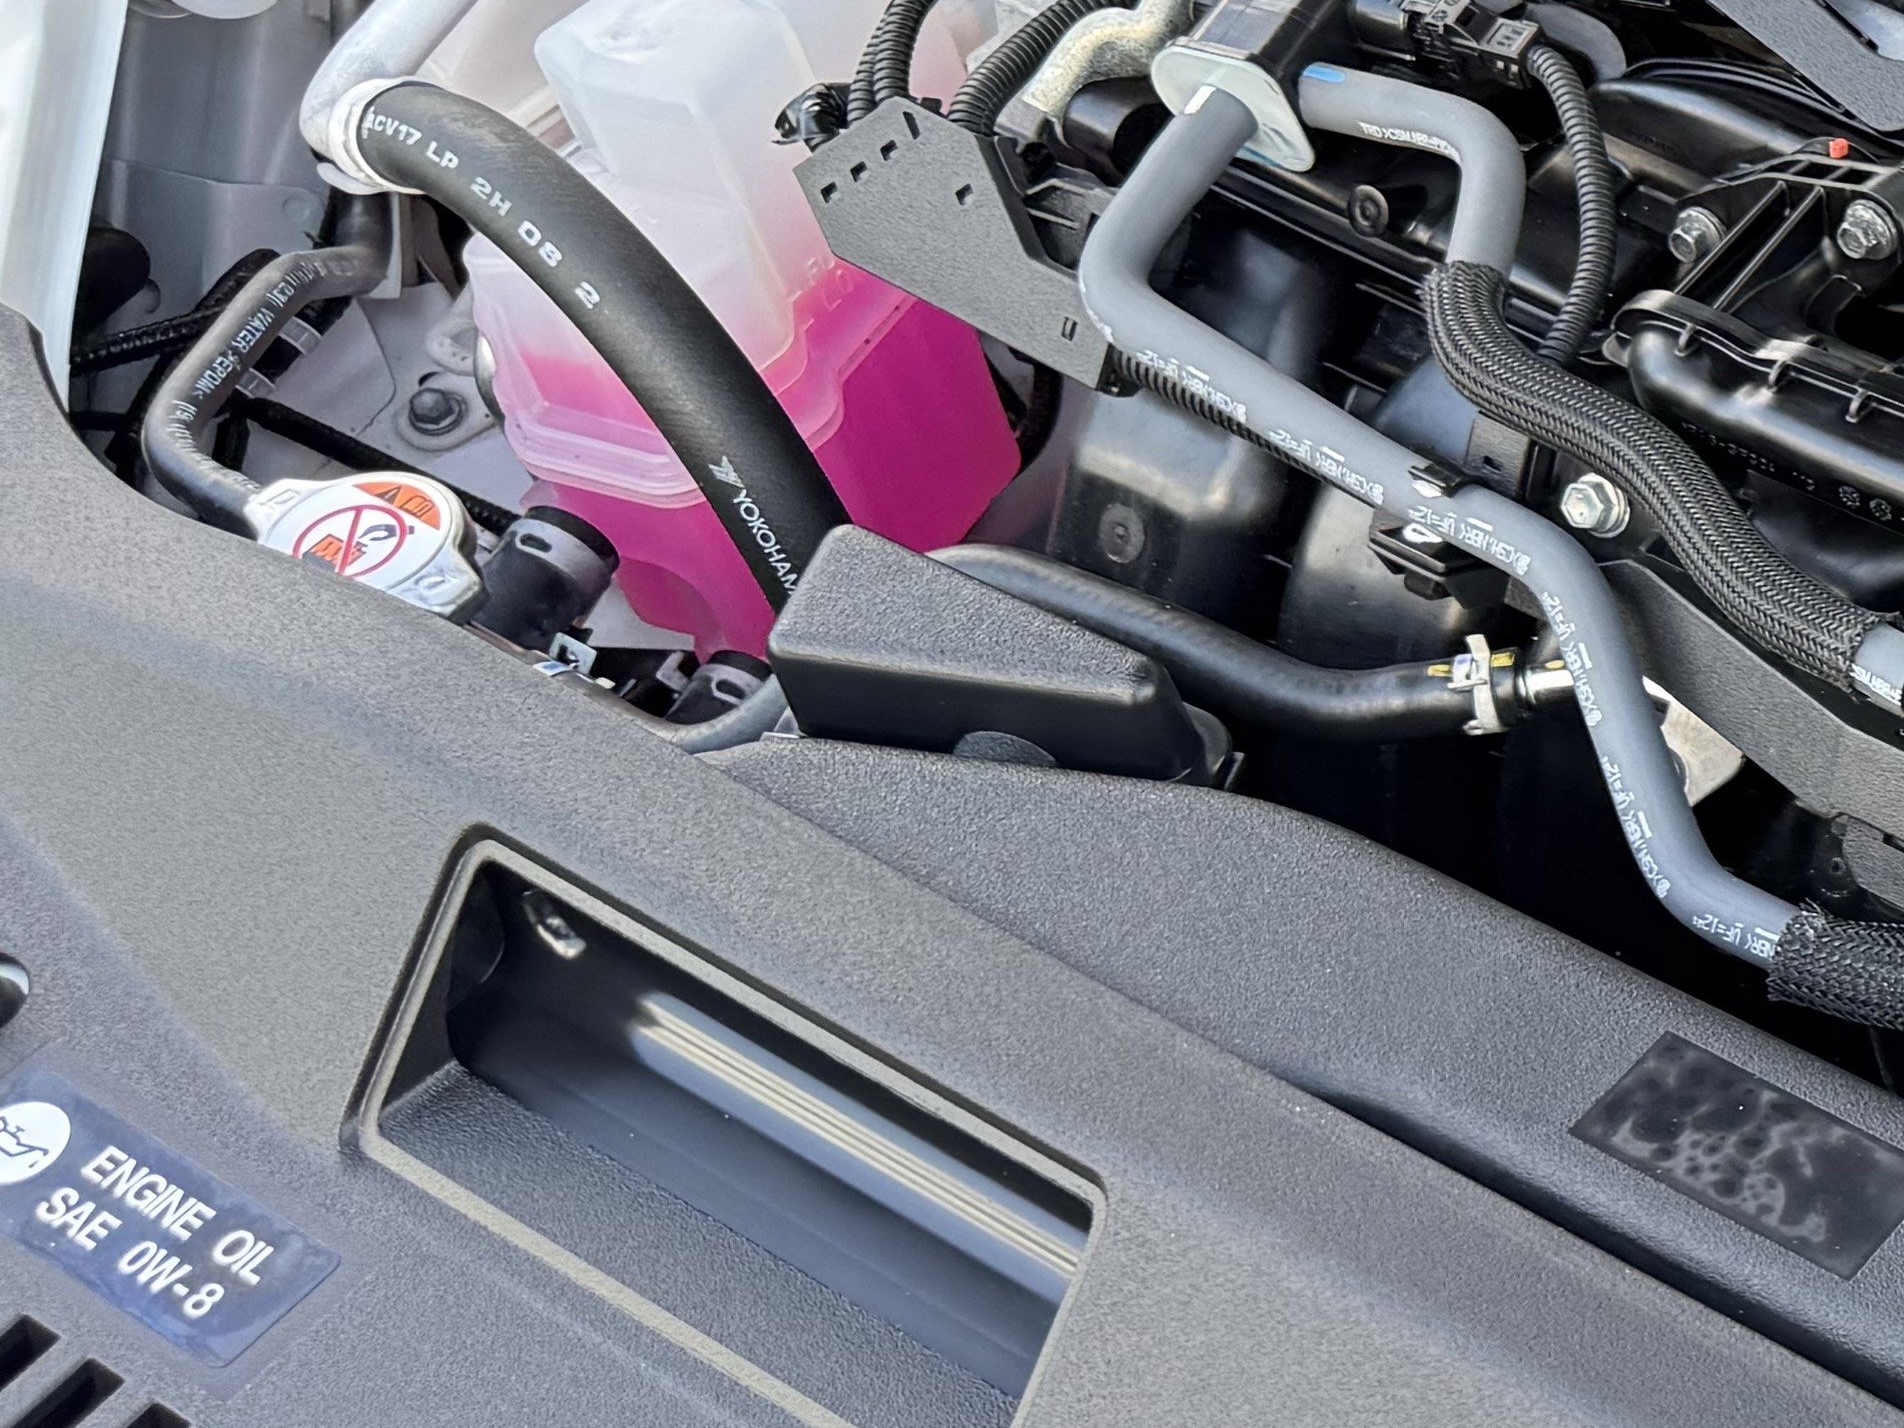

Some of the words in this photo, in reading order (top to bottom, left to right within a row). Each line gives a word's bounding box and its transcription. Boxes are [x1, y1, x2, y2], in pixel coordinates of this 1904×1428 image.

[733, 489, 799, 595] YOKOHAM
[35, 1187, 123, 1250] SAE
[117, 1240, 225, 1319] 0W-8
[80, 1145, 217, 1241] ENGINE
[212, 1230, 274, 1286] OIL
